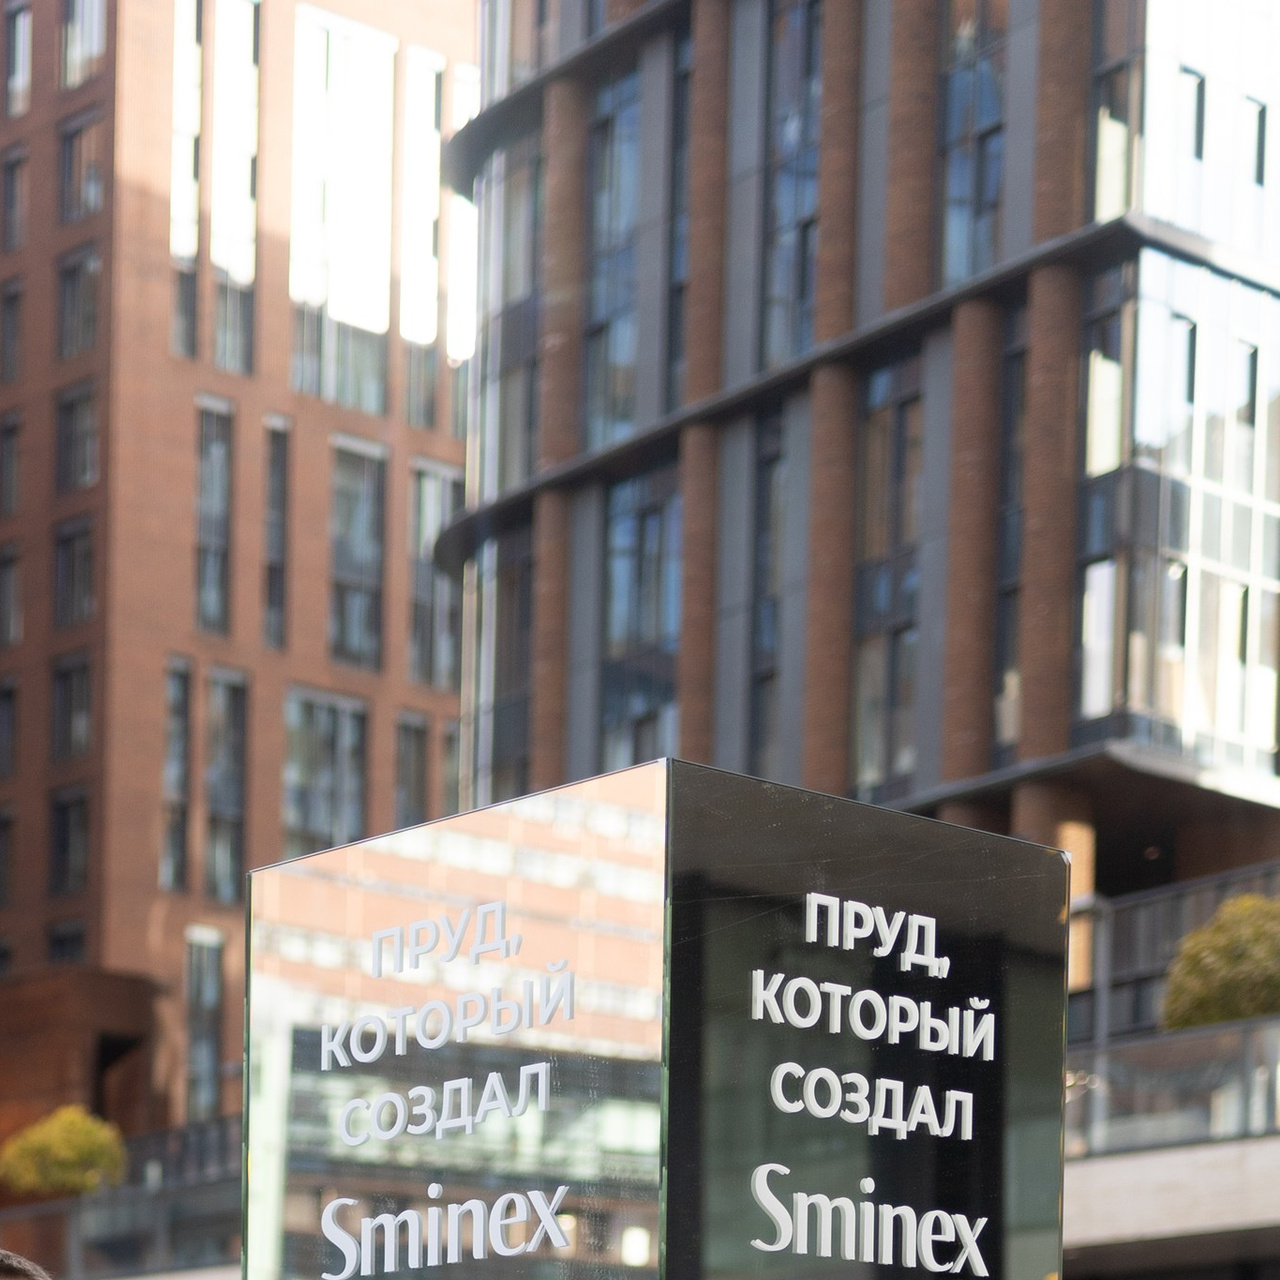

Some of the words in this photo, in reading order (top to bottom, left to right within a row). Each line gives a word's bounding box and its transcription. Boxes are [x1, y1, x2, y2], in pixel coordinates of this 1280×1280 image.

[371, 900, 523, 978] ПРУД,
[805, 892, 951, 979] ПРУД,
[320, 960, 576, 1072] КОТОРЫЙ
[751, 968, 996, 1062] КОТОРЫЙ
[339, 1061, 551, 1147] СОЗДАЛ
[770, 1061, 974, 1141] СОЗДАЛ
[750, 1163, 989, 1278] Sminex
